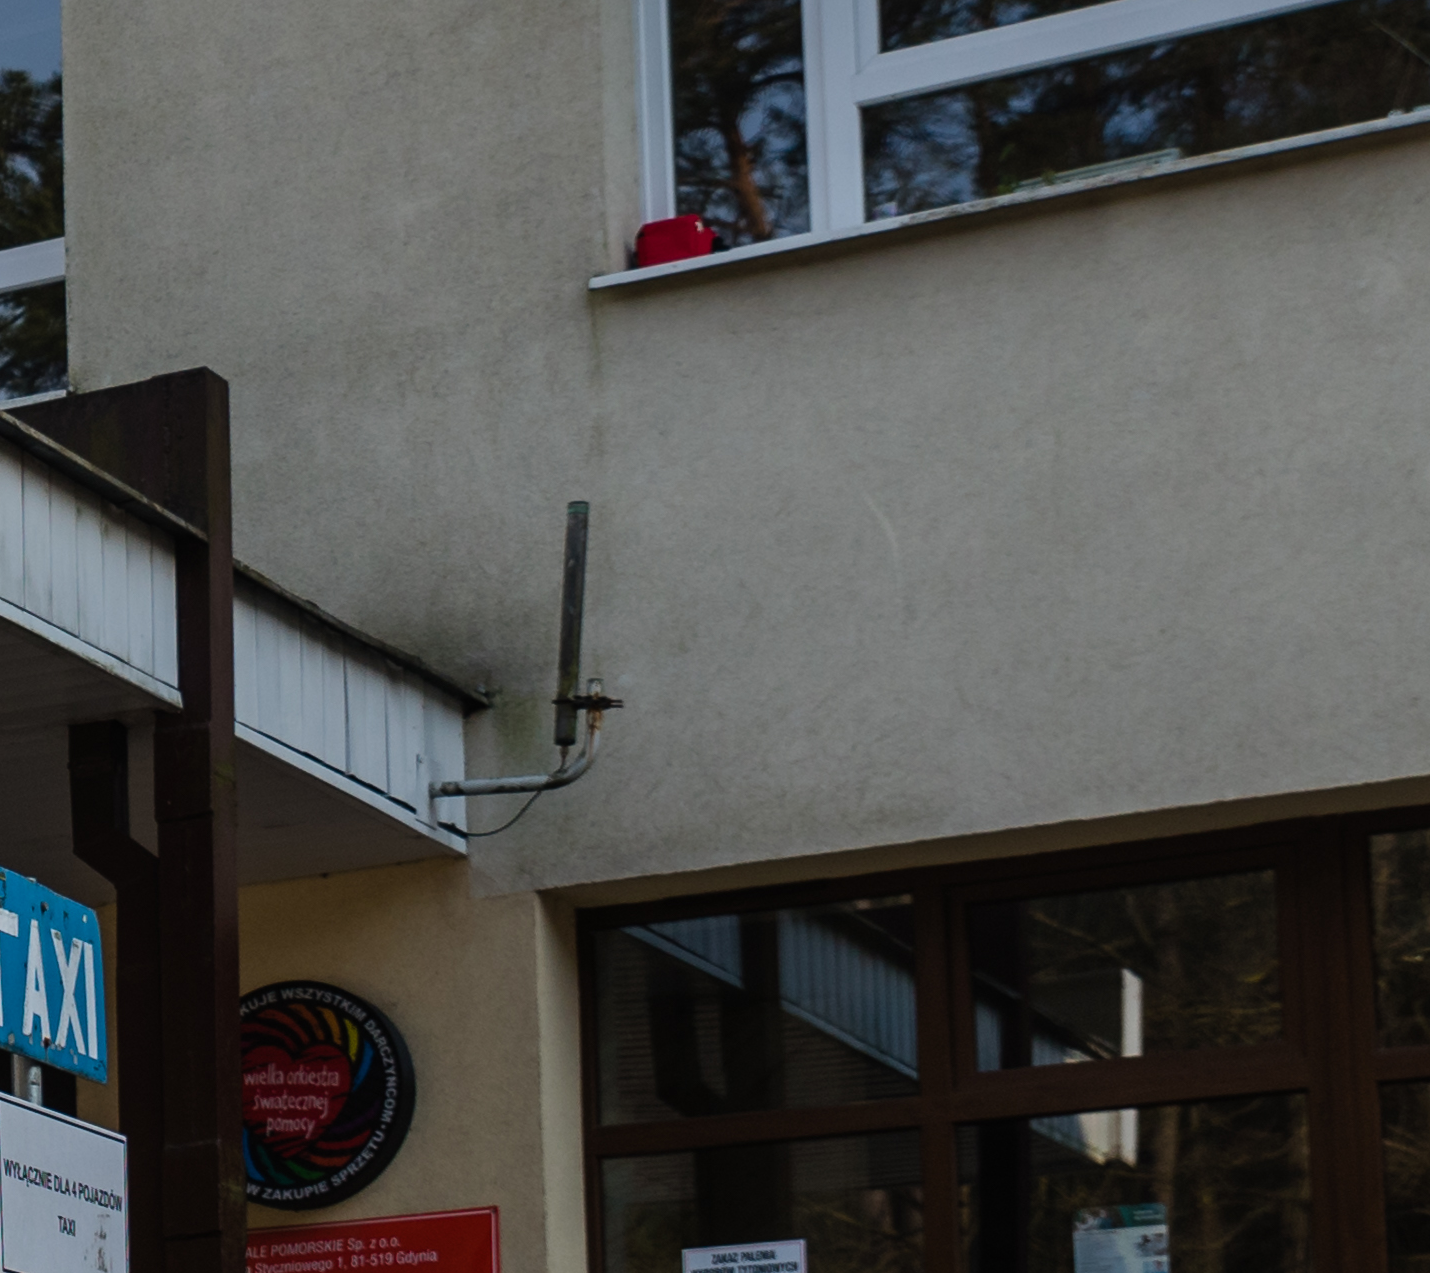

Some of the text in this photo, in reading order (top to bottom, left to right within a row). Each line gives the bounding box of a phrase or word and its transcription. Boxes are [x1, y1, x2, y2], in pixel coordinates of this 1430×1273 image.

[240, 989, 278, 1016] KUJE
[280, 987, 369, 1022] WSZYSTKIM
[243, 1063, 340, 1087] wielka orkiestra
[266, 1117, 316, 1139] pomocy
[3, 1158, 123, 1213] WYŁĄCZNIE DLA 4 POJAZDÓW
[246, 1182, 260, 1196] W
[261, 1180, 330, 1201] ZAKUPIE
[57, 1215, 76, 1237] TAXI
[246, 1245, 267, 1259] ALE
[270, 1238, 343, 1257] POMORSKIE
[347, 1238, 365, 1253] Sp.
[350, 1252, 393, 1269] 81-519
[396, 1249, 438, 1266] Gdynia
